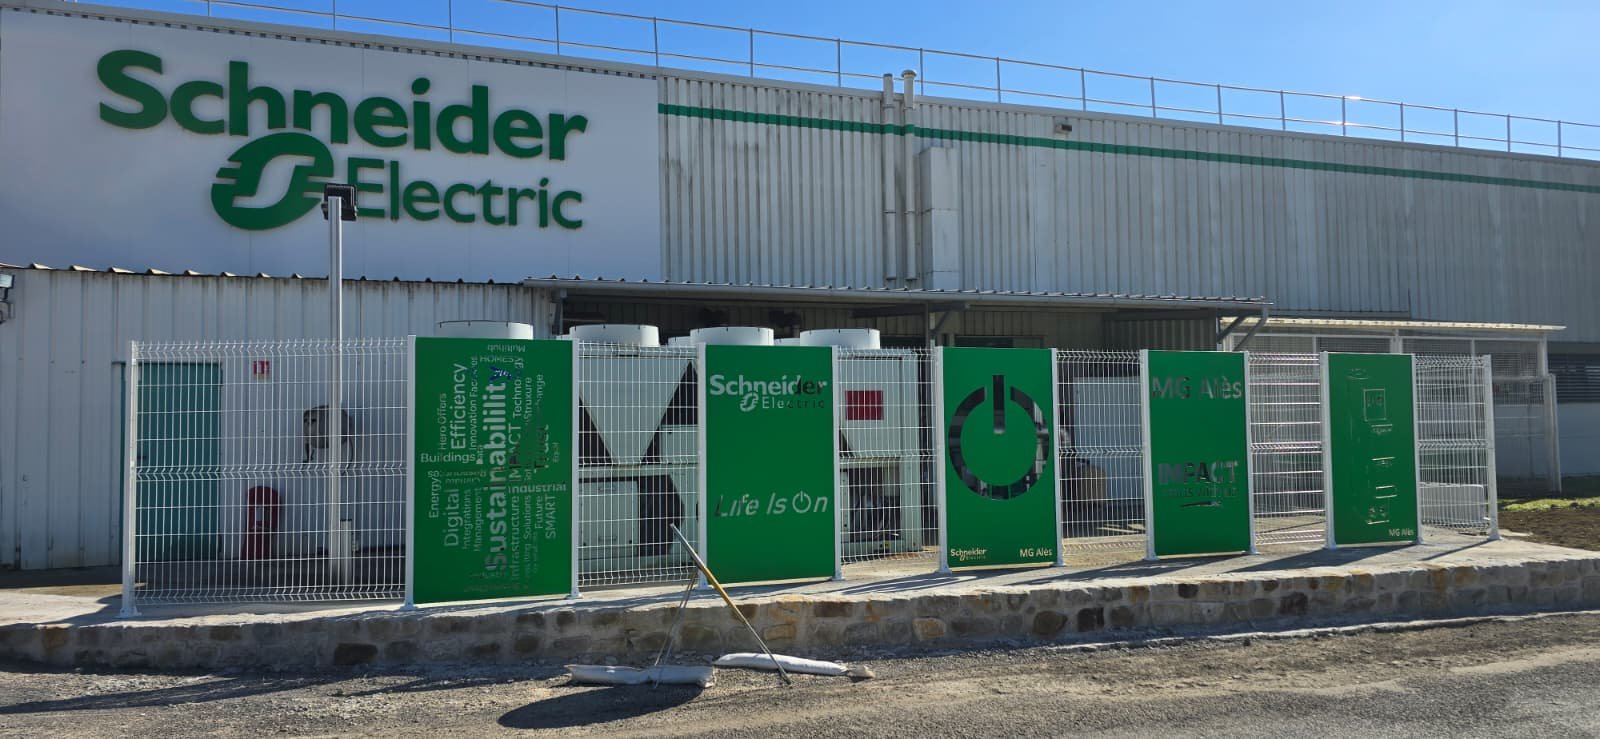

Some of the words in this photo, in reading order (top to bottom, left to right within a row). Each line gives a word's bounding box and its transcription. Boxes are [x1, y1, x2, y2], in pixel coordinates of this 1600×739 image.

[97, 49, 588, 161] Schneider
[346, 157, 583, 230] Electric
[512, 357, 525, 419] Technogy
[709, 374, 828, 396] Schneider
[1152, 376, 1192, 400] MG
[1199, 375, 1243, 400] Alès
[437, 393, 447, 425] Offers
[450, 363, 468, 450] Efficiency
[761, 396, 825, 409] Electric
[439, 427, 447, 450] Hero
[468, 400, 478, 450] Innovation
[420, 453, 476, 465] Buildings
[1158, 461, 1239, 485] IMPACT
[429, 476, 442, 519] Energy
[535, 495, 543, 529] Future
[714, 493, 760, 517] Life
[766, 492, 789, 515] Is
[443, 488, 463, 547] Digital
[462, 489, 473, 550] Integrations
[474, 487, 484, 552] Management
[523, 495, 532, 540] Solutions
[545, 494, 557, 540] SMART
[1388, 528, 1401, 537] MG
[950, 547, 988, 558] Schneider
[1019, 548, 1034, 558] MG
